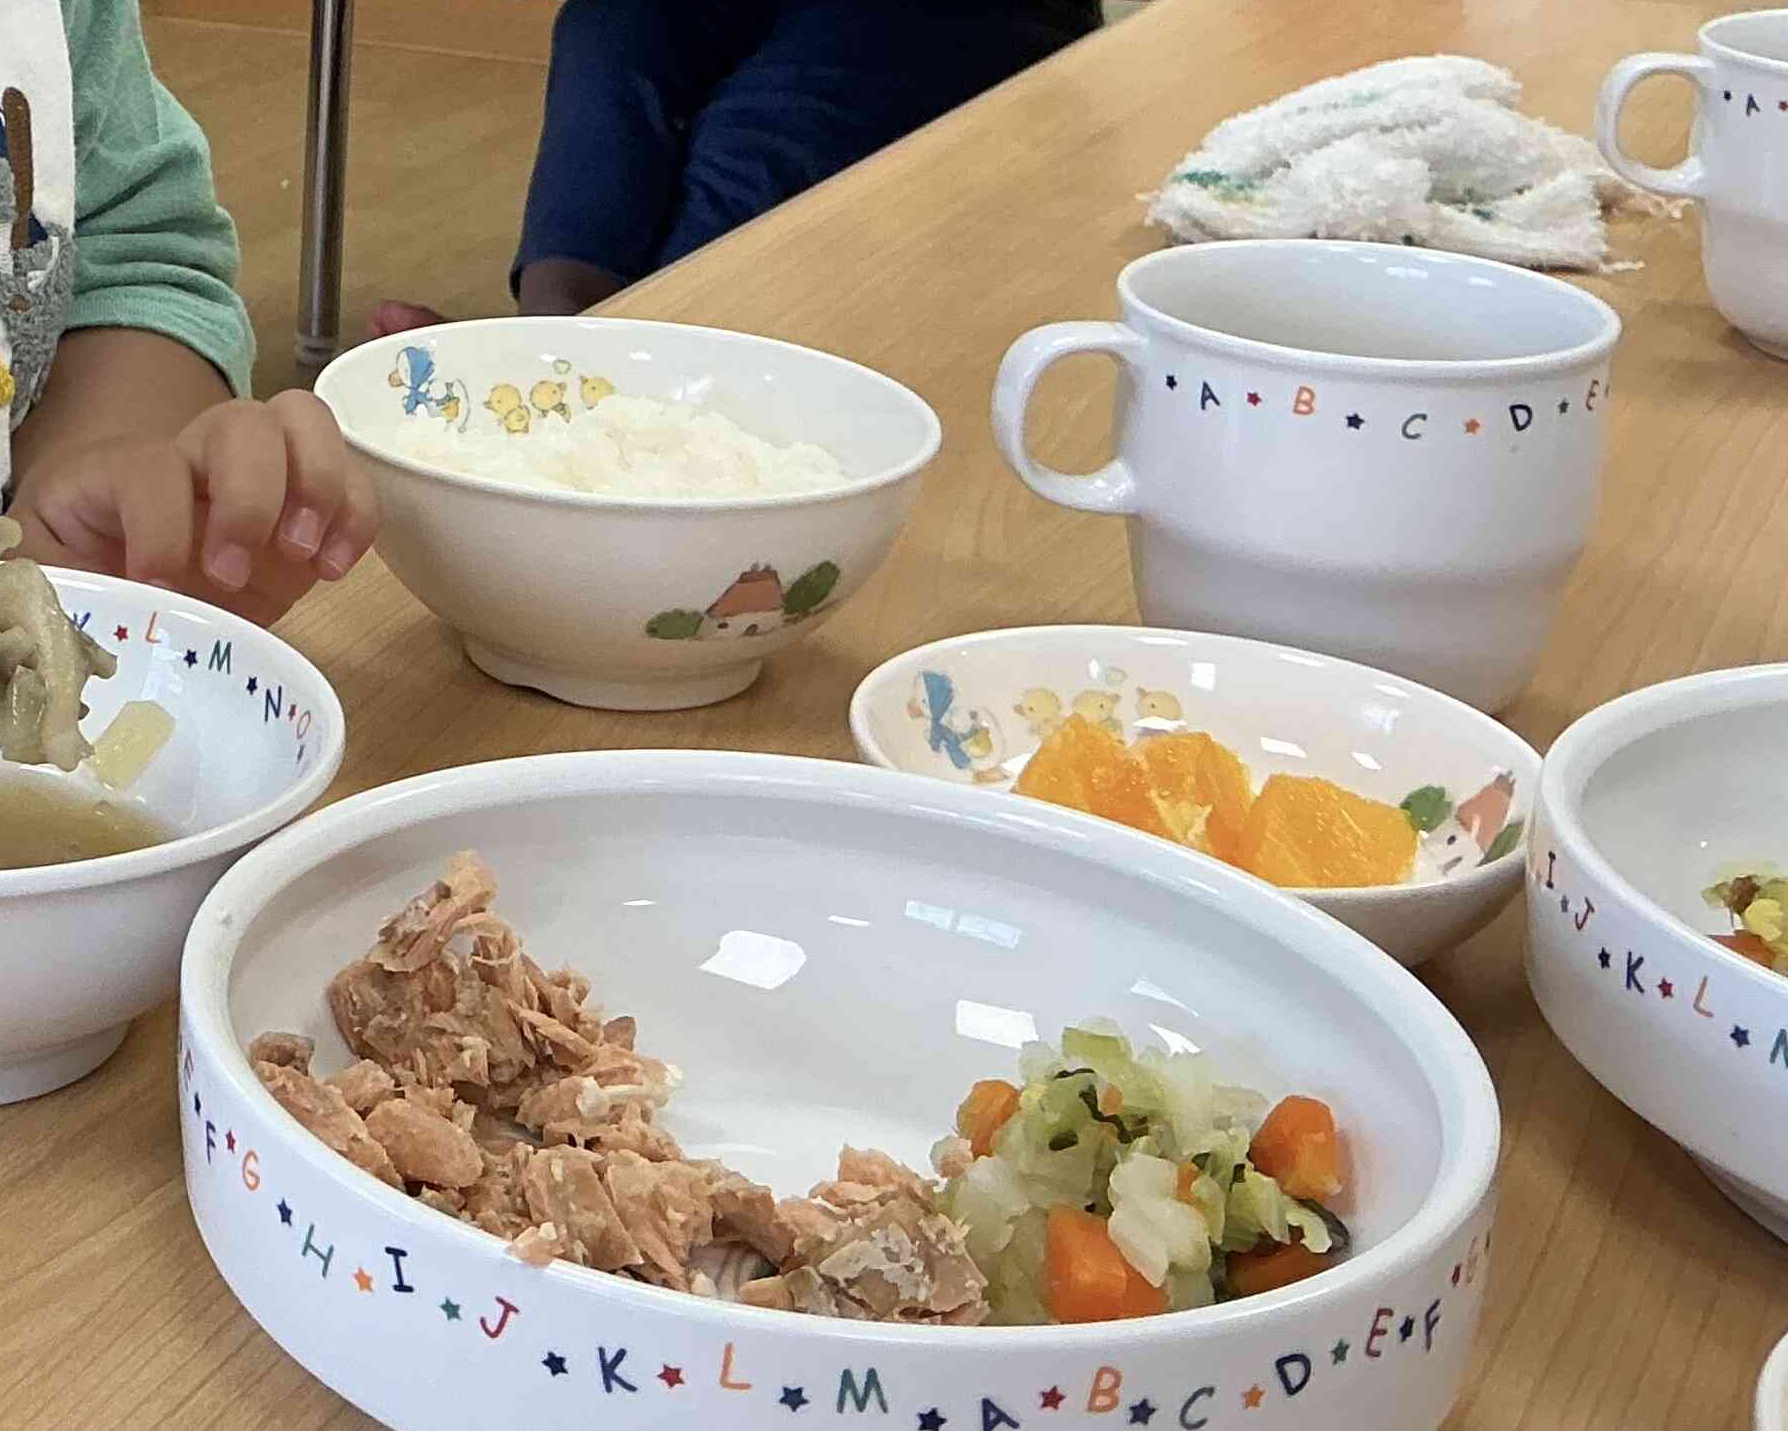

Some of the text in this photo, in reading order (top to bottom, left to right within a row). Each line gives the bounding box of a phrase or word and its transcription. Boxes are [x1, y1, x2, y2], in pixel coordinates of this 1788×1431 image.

[1745, 93, 1760, 116] A
[1200, 379, 1600, 440] A B C D E
[145, 611, 160, 644] L
[208, 639, 232, 674] M
[264, 685, 282, 722] N
[1575, 896, 1595, 931] J
[1626, 951, 1645, 994] K
[1693, 975, 1714, 1018] L
[205, 1120, 217, 1165] F
[242, 1149, 261, 1192] G
[301, 1223, 335, 1279] H
[385, 1246, 415, 1293] I
[479, 1296, 521, 1339] J
[597, 1346, 639, 1393] K
[719, 1341, 753, 1390] L
[836, 1367, 889, 1414] M
[981, 1398, 1021, 1431] A
[1086, 1365, 1123, 1414] B
[1178, 1386, 1216, 1431] C
[1274, 1352, 1312, 1397] D
[1365, 1307, 1394, 1358] E
[1424, 1298, 1441, 1353] F
